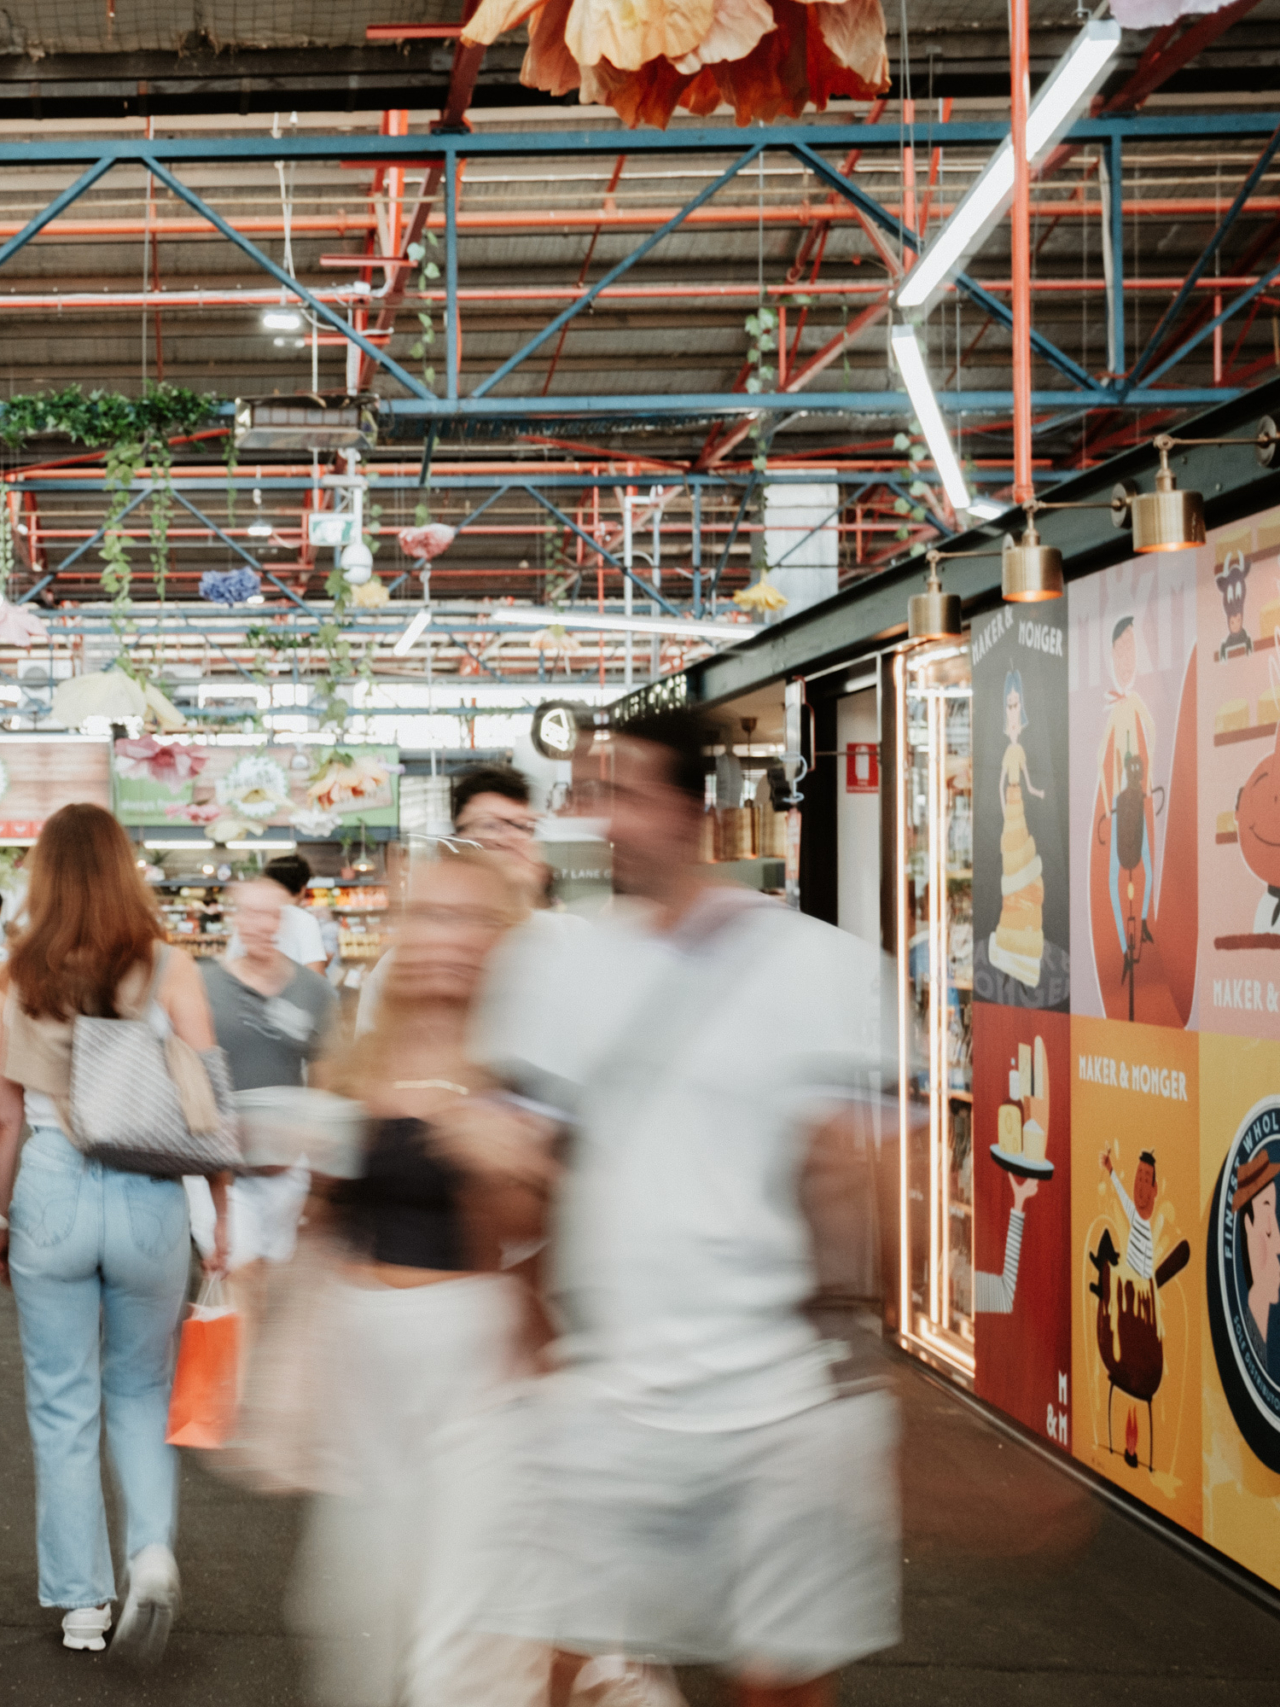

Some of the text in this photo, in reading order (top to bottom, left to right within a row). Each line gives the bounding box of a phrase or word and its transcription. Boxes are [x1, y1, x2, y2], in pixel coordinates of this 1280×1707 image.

[972, 611, 1005, 666] MAKER
[1018, 619, 1063, 657] MONGER
[570, 867, 600, 880] LANE
[1213, 978, 1279, 1013] MAKER &
[1079, 1054, 1188, 1102] MAKER & MONGER
